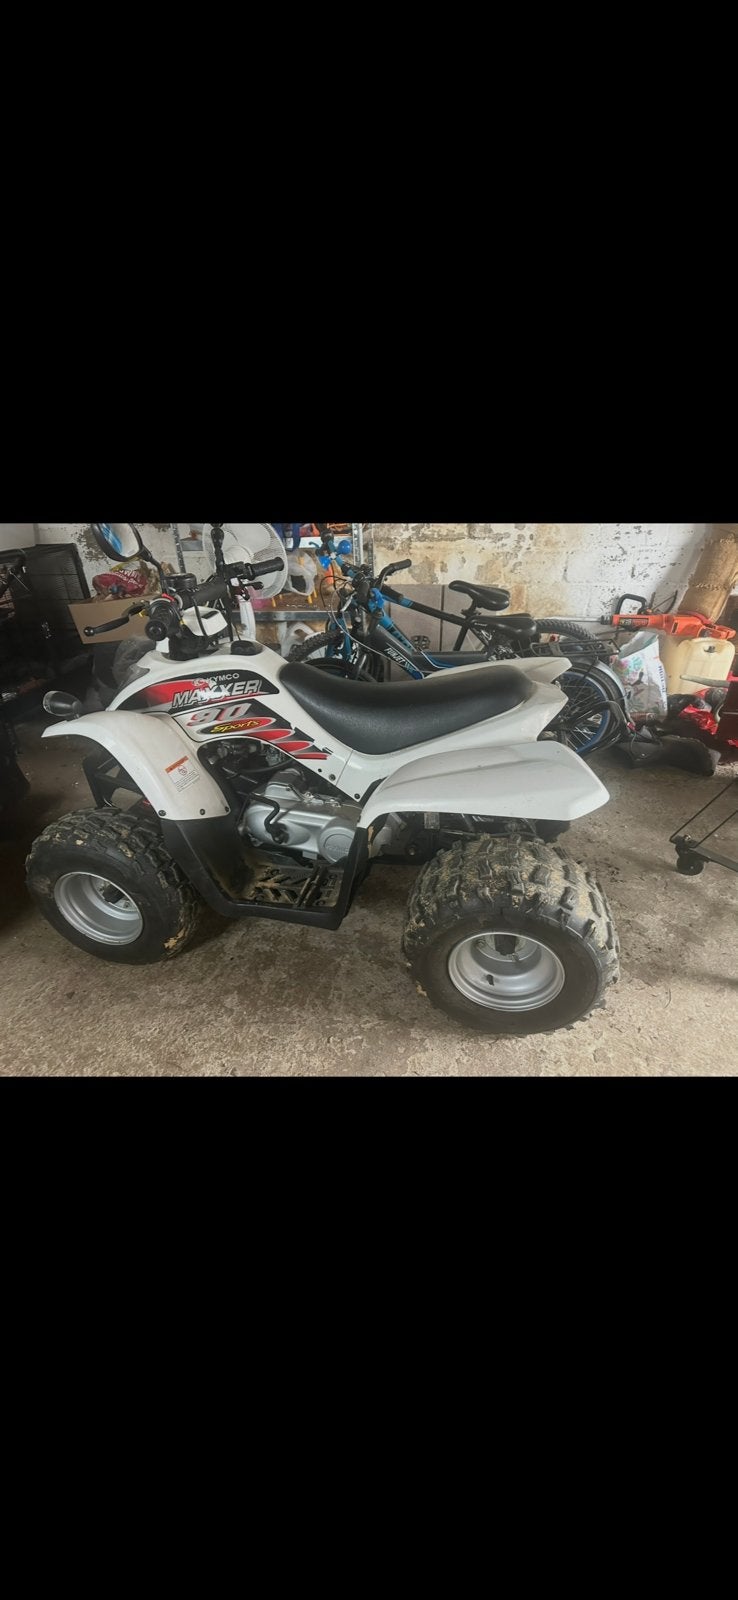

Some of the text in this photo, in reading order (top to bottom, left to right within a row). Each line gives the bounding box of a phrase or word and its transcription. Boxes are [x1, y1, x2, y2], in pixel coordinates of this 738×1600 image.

[172, 680, 260, 708] MAXXER
[186, 703, 252, 727] 90
[210, 720, 259, 733] Sports
